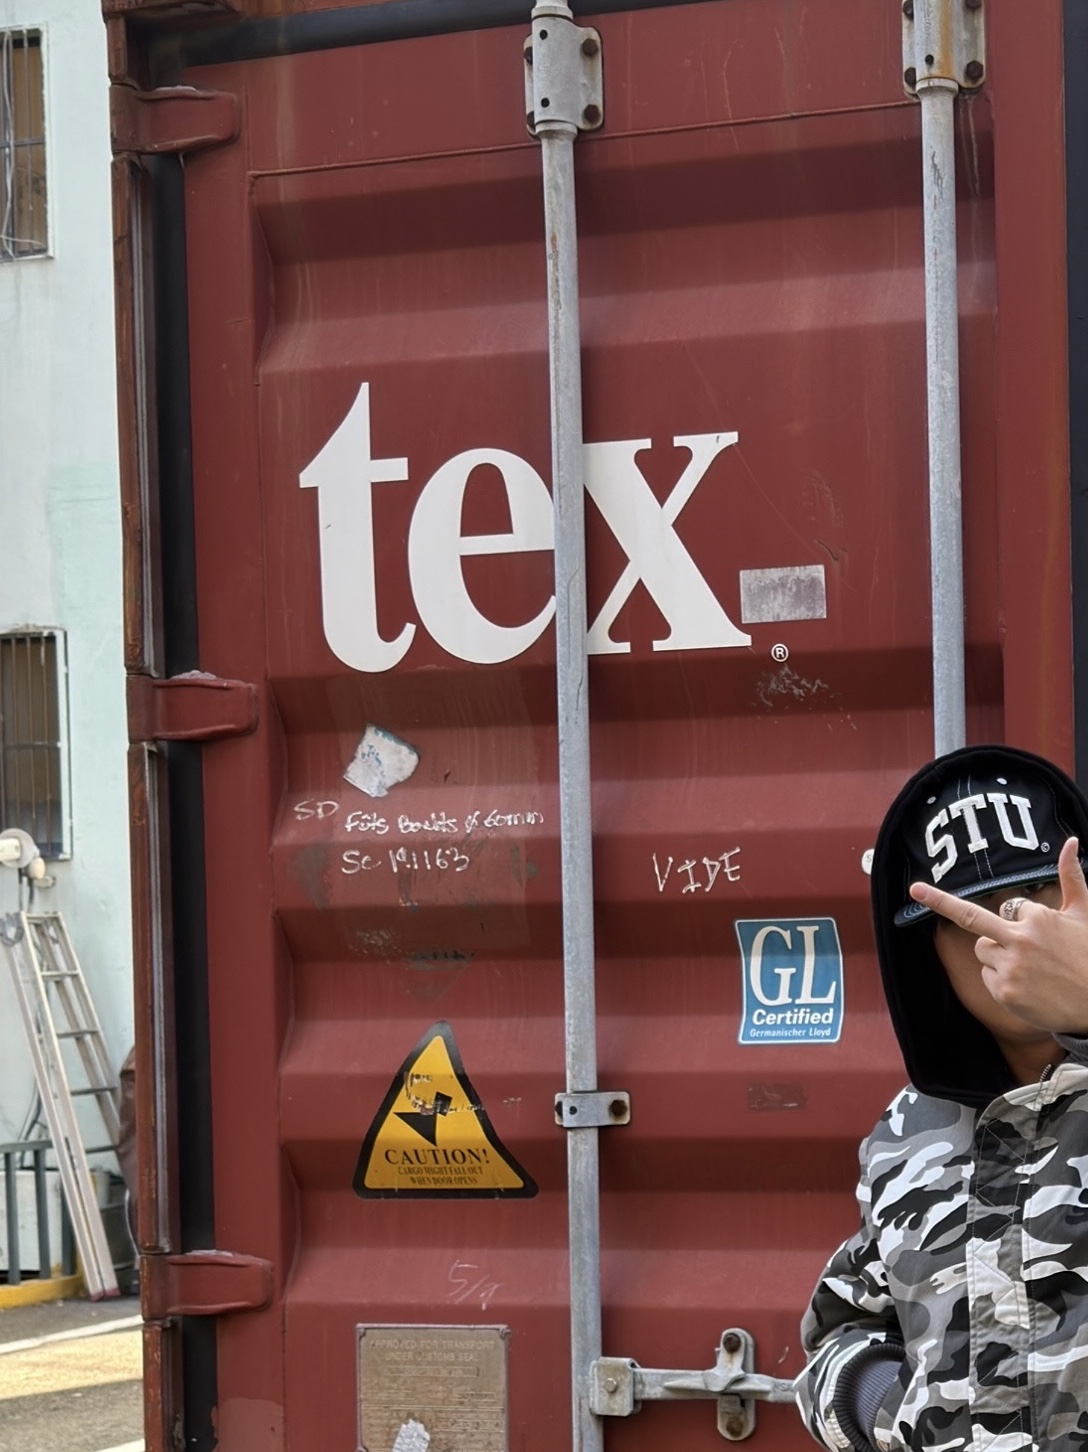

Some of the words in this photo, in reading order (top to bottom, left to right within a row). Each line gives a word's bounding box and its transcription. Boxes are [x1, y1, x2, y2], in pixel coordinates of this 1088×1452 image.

[299, 382, 752, 672] tex
[925, 792, 1040, 884] STU
[653, 847, 741, 893] VIDE
[750, 925, 837, 1007] GL
[750, 1028, 806, 1037] Germanischer
[809, 1027, 832, 1038] Lloyd
[752, 1008, 834, 1026] Certified
[384, 1148, 490, 1166] CAUTION!
